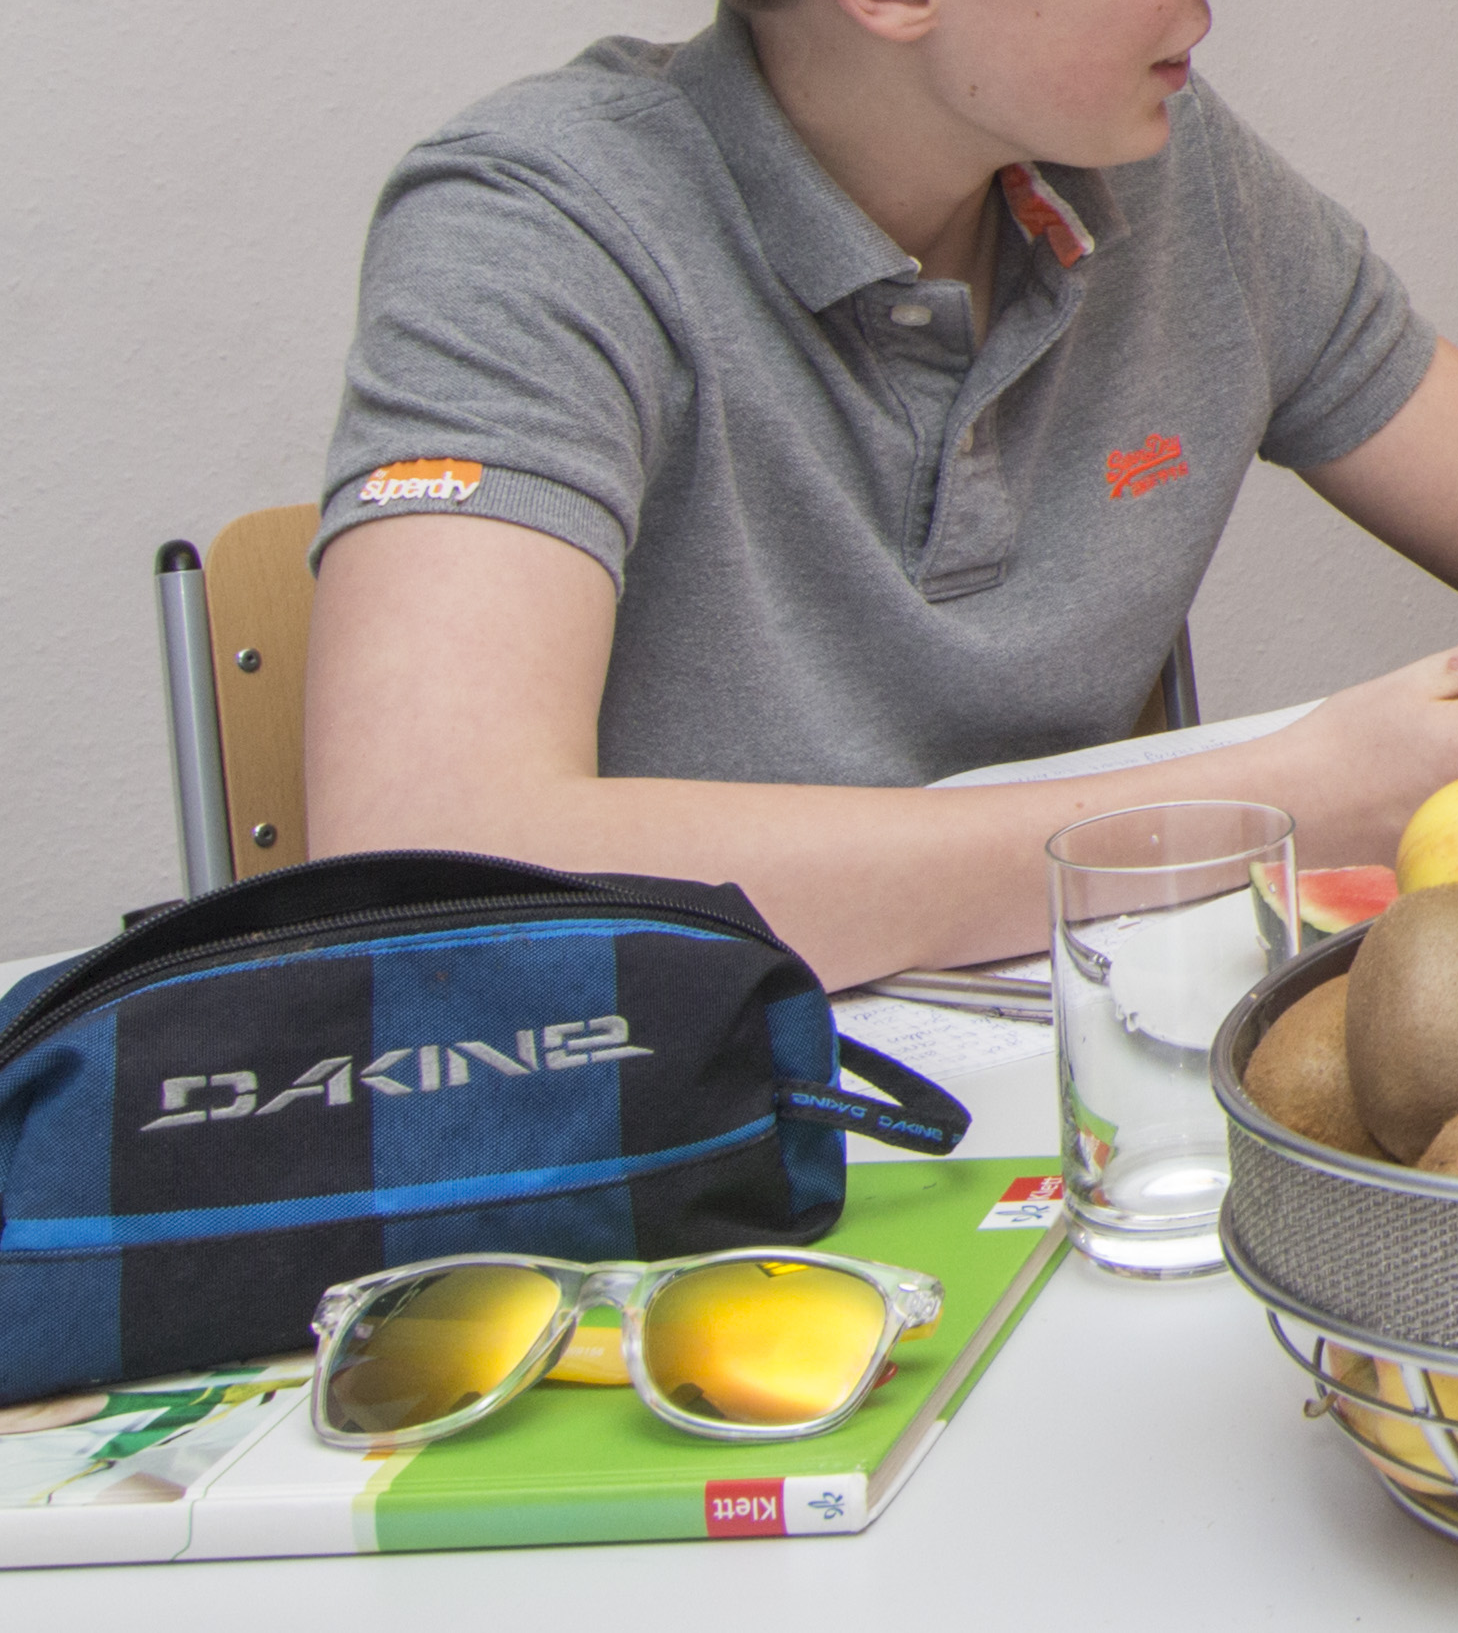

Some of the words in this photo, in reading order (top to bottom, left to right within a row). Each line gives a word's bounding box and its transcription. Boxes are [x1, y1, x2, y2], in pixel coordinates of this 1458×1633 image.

[359, 470, 480, 506] superdry
[140, 1014, 655, 1131] DAKINE
[712, 1495, 778, 1522] Klett
